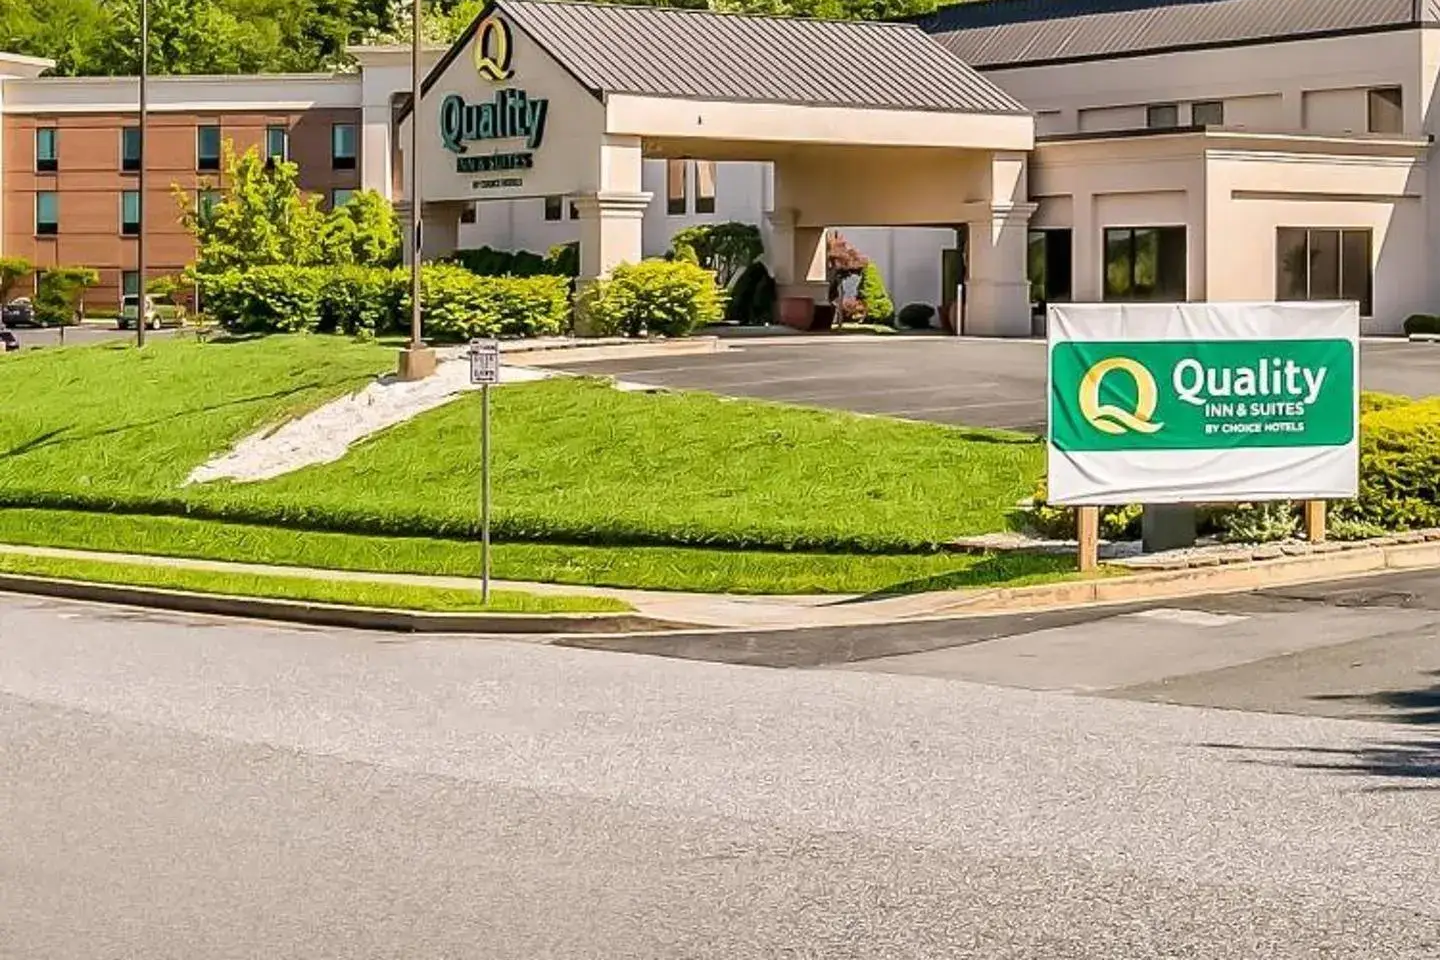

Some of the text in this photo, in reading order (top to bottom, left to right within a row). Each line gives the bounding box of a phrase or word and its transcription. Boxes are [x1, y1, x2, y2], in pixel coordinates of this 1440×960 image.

[473, 17, 514, 81] Q
[440, 88, 549, 153] Quality
[1078, 356, 1165, 435] Q
[1173, 357, 1327, 405] Quality
[1205, 401, 1305, 417] INN & SUITES
[1205, 421, 1305, 434] BY CHOICE HOTELS
